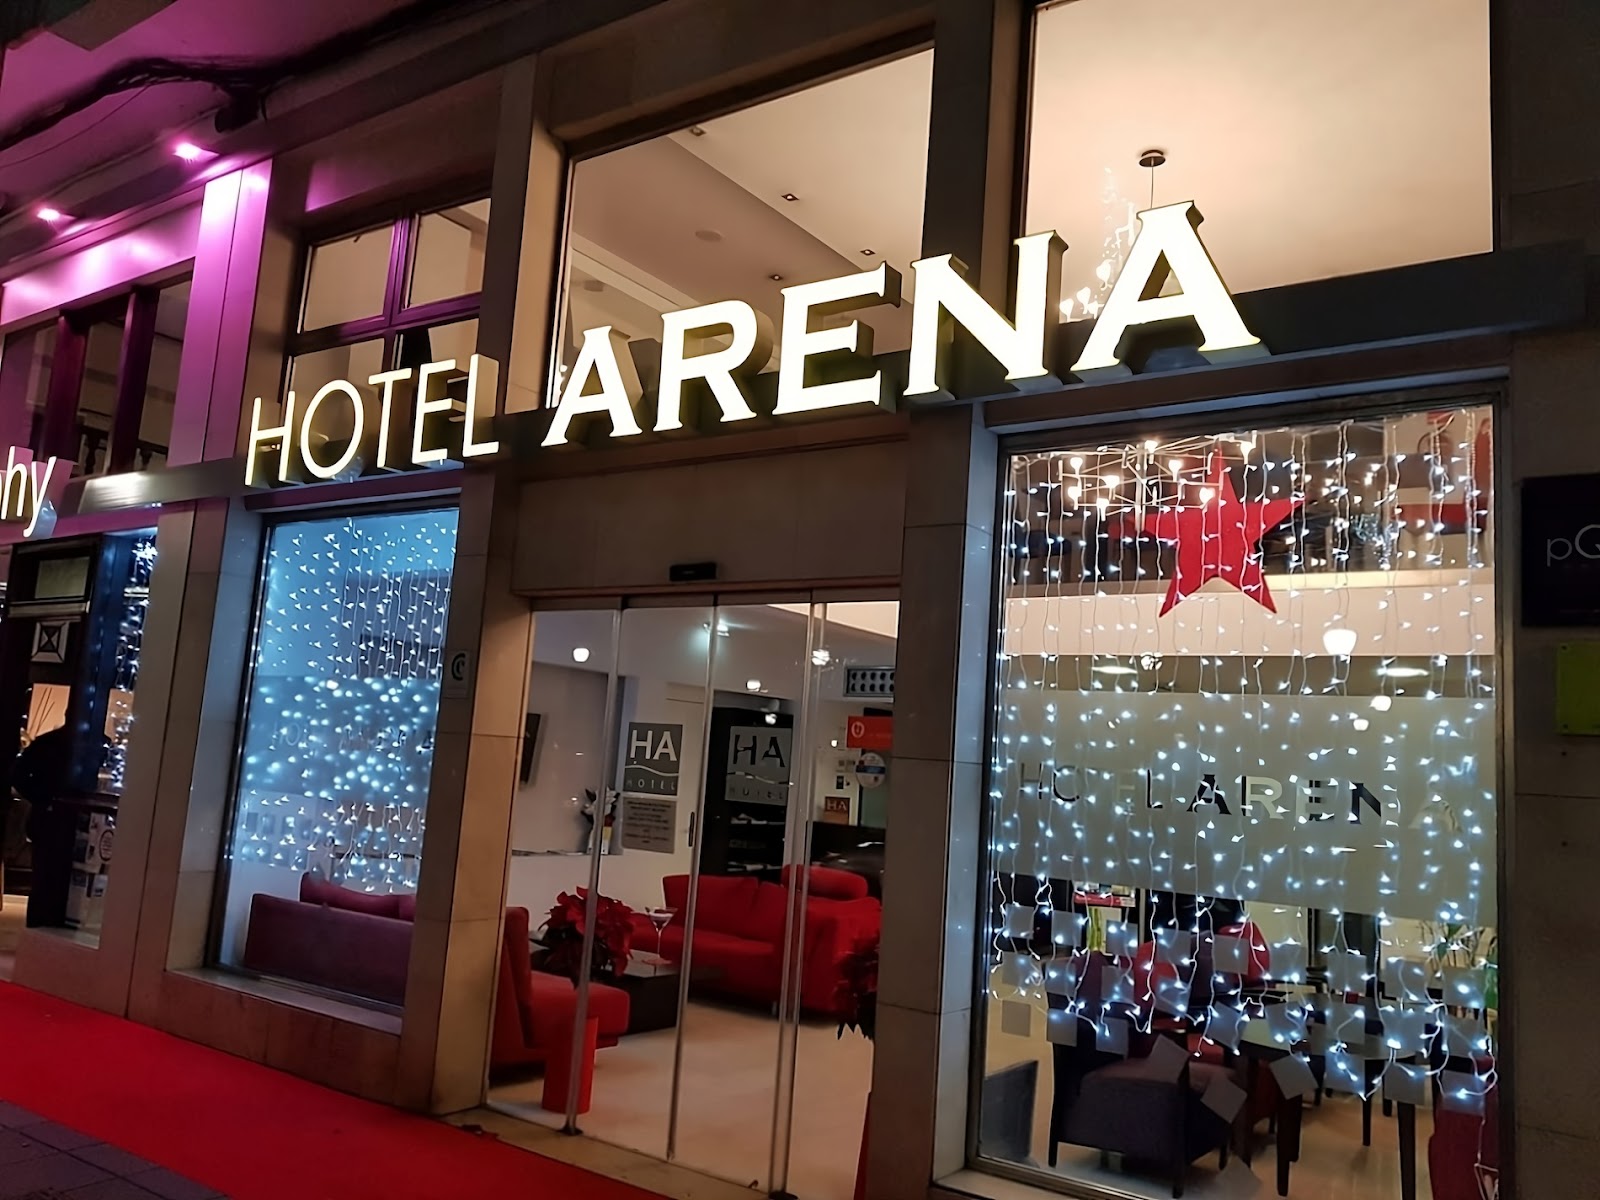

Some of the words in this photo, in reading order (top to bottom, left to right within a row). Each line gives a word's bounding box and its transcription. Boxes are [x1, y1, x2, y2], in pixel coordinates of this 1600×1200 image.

[245, 354, 500, 487] HOTEL
[541, 200, 1260, 447] ARENA
[0, 446, 57, 537] hy
[629, 729, 677, 762] HA
[732, 734, 786, 768] HA
[826, 800, 848, 812] HA
